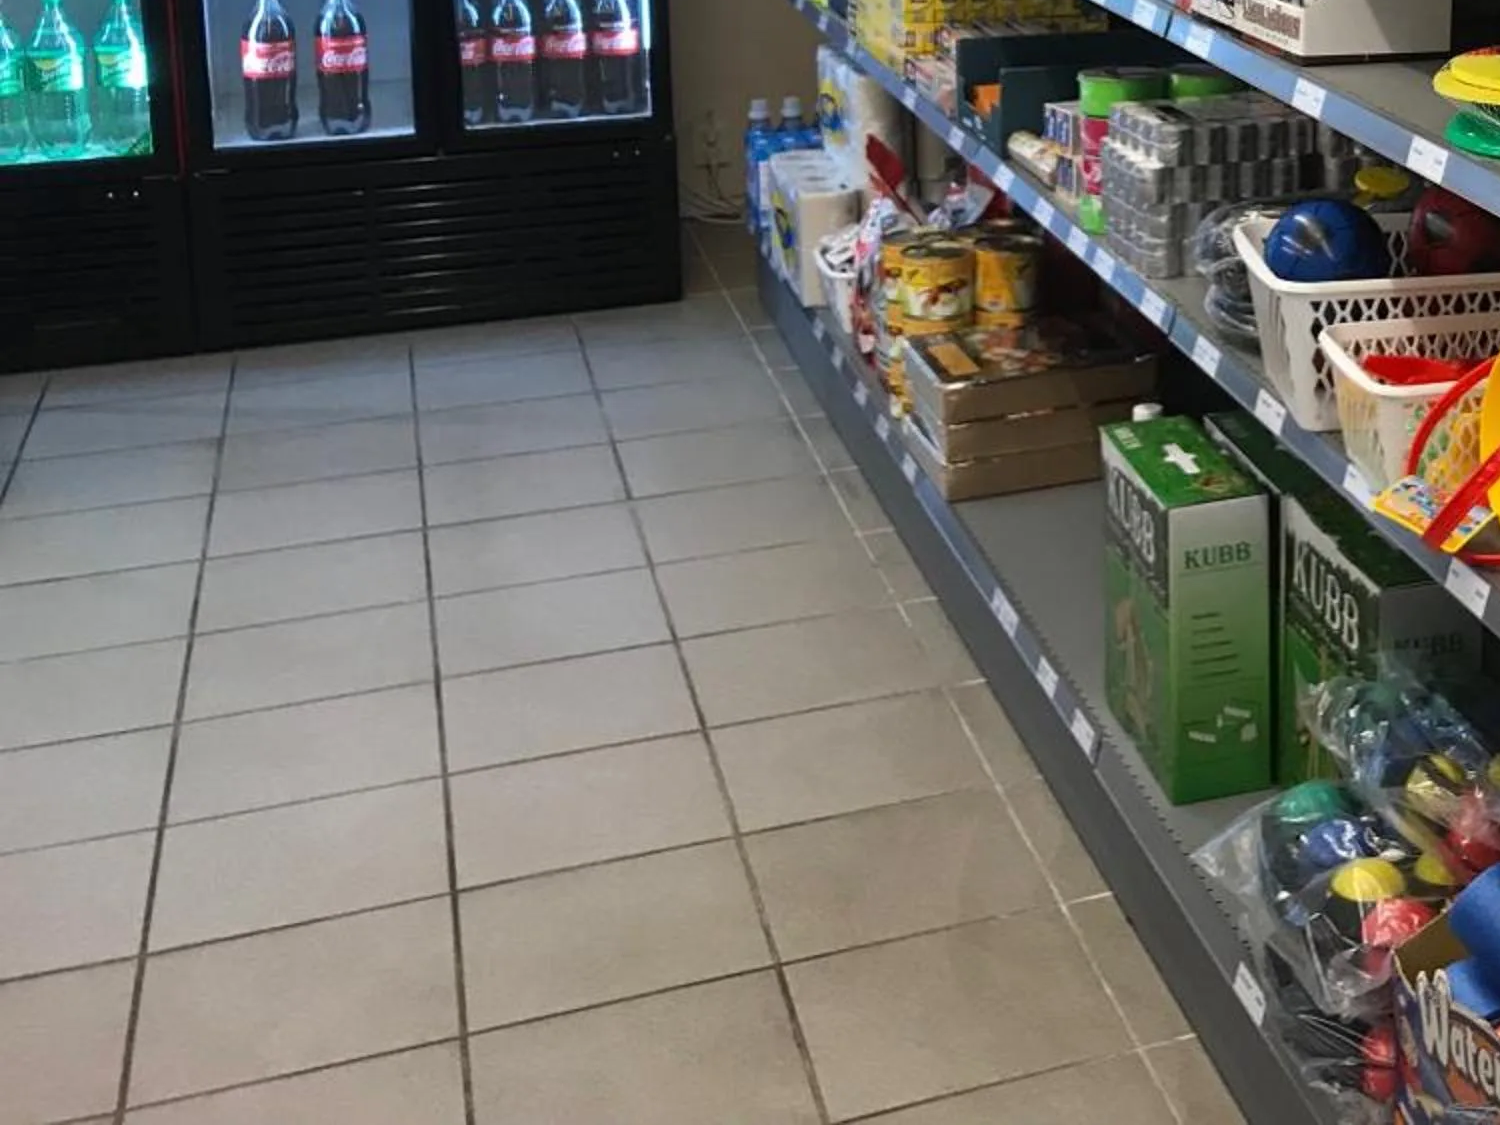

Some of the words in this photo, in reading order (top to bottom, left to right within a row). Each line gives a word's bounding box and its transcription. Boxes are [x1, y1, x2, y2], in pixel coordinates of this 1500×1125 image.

[1108, 466, 1156, 566] KUBB
[1183, 540, 1253, 570] KUBB
[1293, 540, 1360, 651] KUBB
